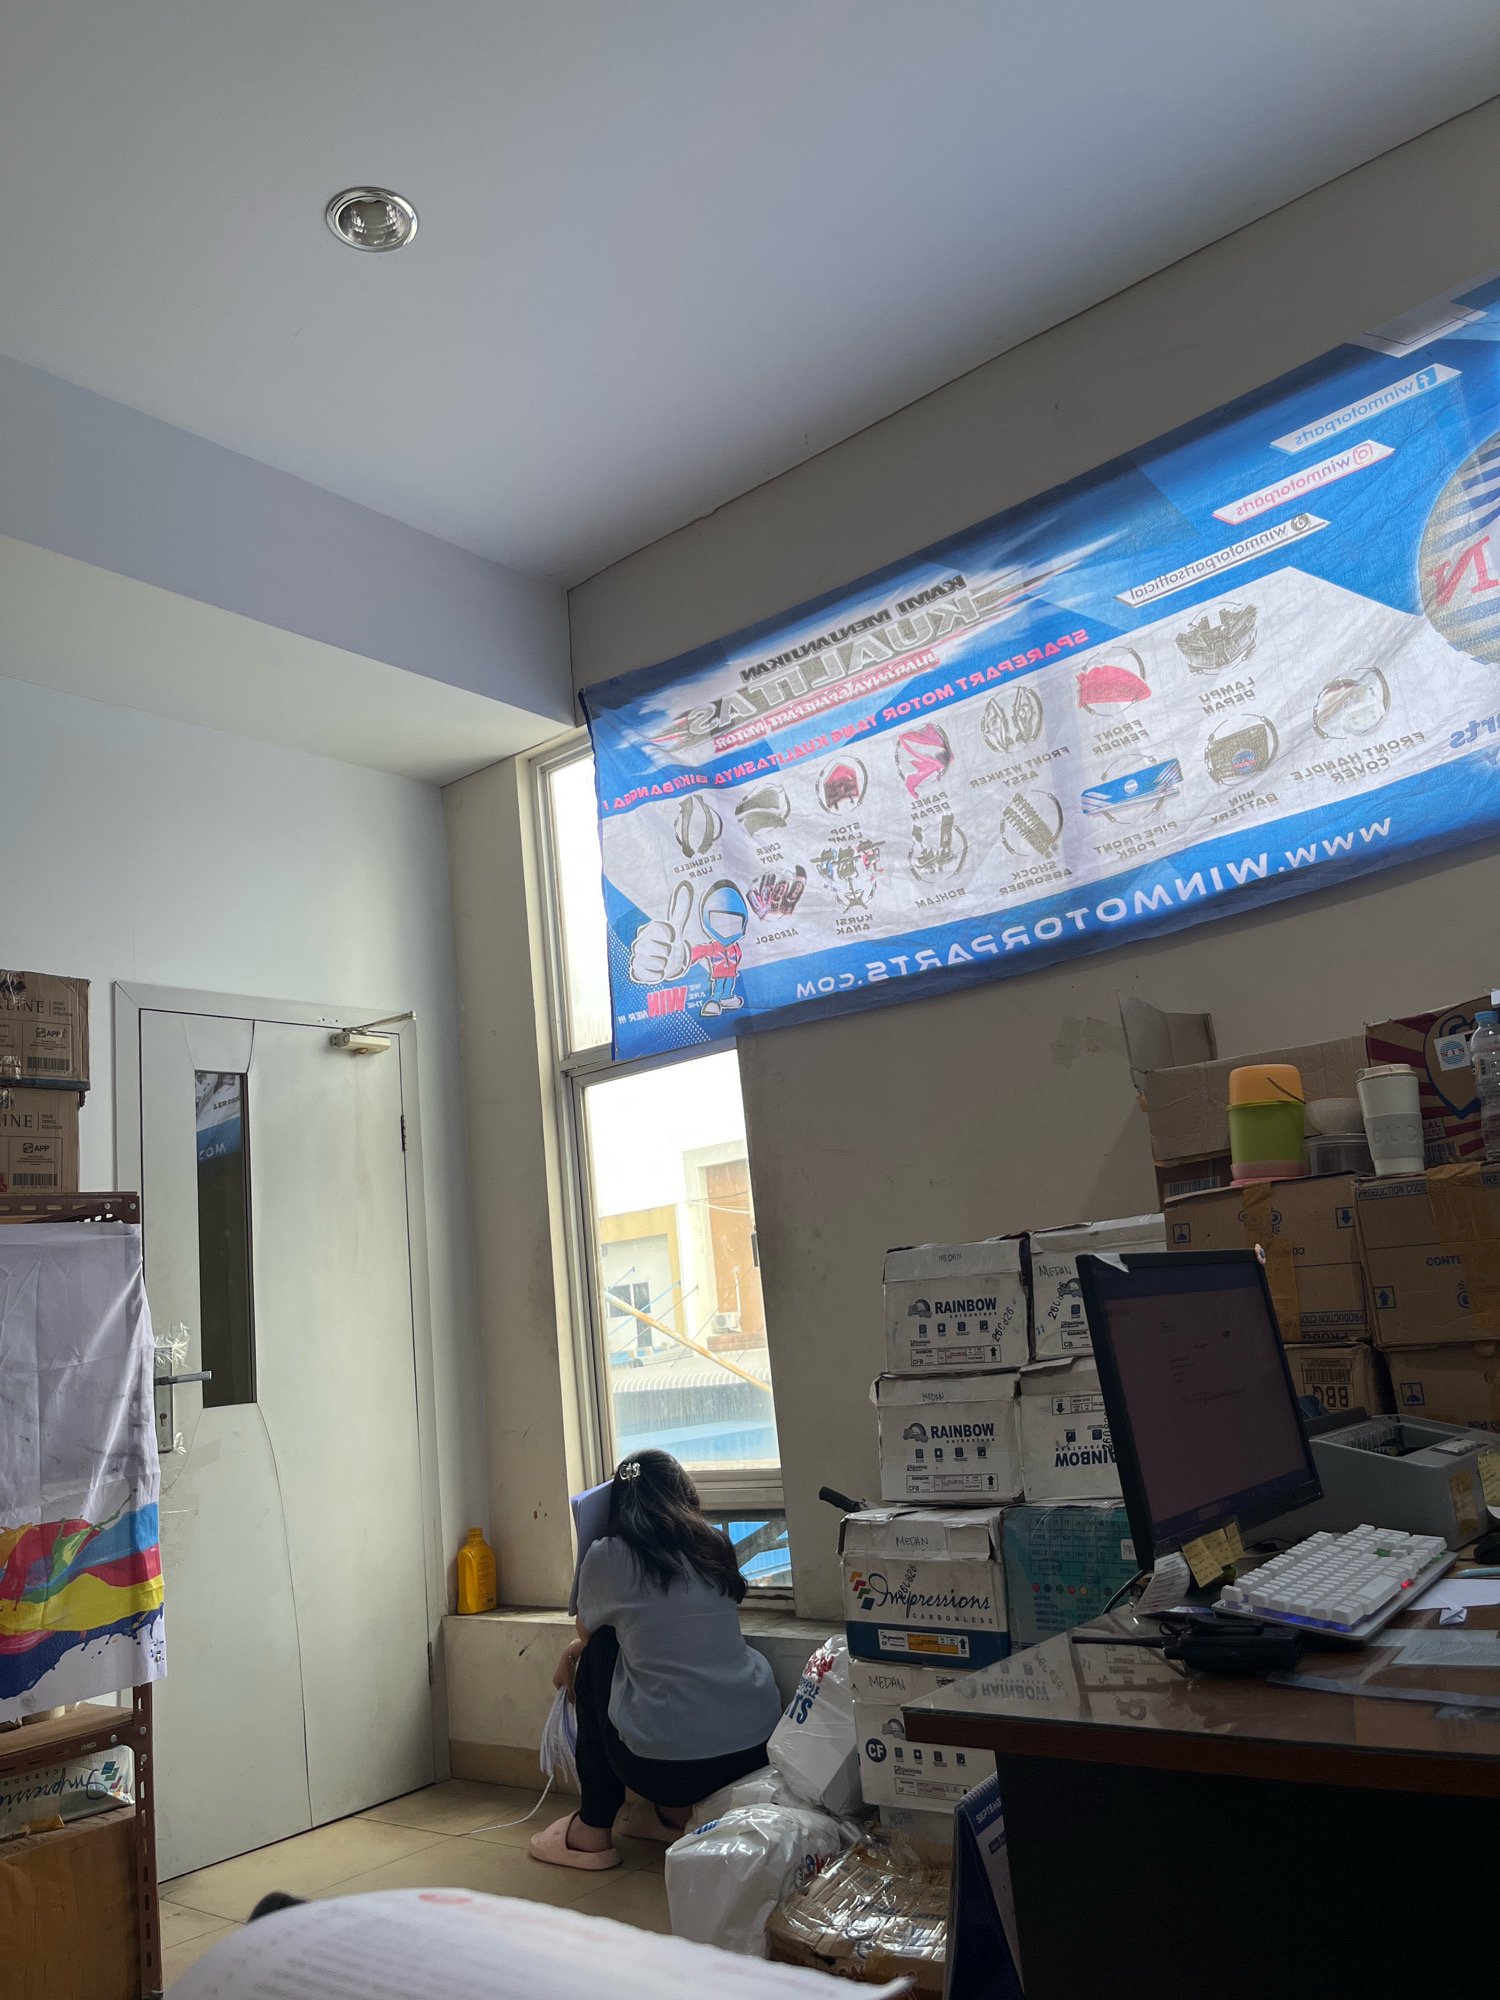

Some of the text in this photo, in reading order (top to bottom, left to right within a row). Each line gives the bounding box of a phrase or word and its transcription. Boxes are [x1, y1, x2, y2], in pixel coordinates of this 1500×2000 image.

[47, 1030, 60, 1038] APP
[1440, 1048, 1465, 1058] WIN
[1357, 1182, 1427, 1199] PRODUCTION CODE
[938, 1252, 962, 1262] MEDAN
[1038, 1265, 1072, 1278] MEDAN
[935, 1297, 997, 1314] RAINBOW
[1319, 1312, 1365, 1324] PRODUCTION
[931, 1423, 994, 1439] RAINBOW
[895, 1536, 929, 1547] MEDAN
[868, 1573, 991, 1619] Impressions
[912, 1613, 993, 1624] CARBONLESS
[868, 1675, 906, 1691] MEDAN
[868, 1743, 884, 1754] CF
